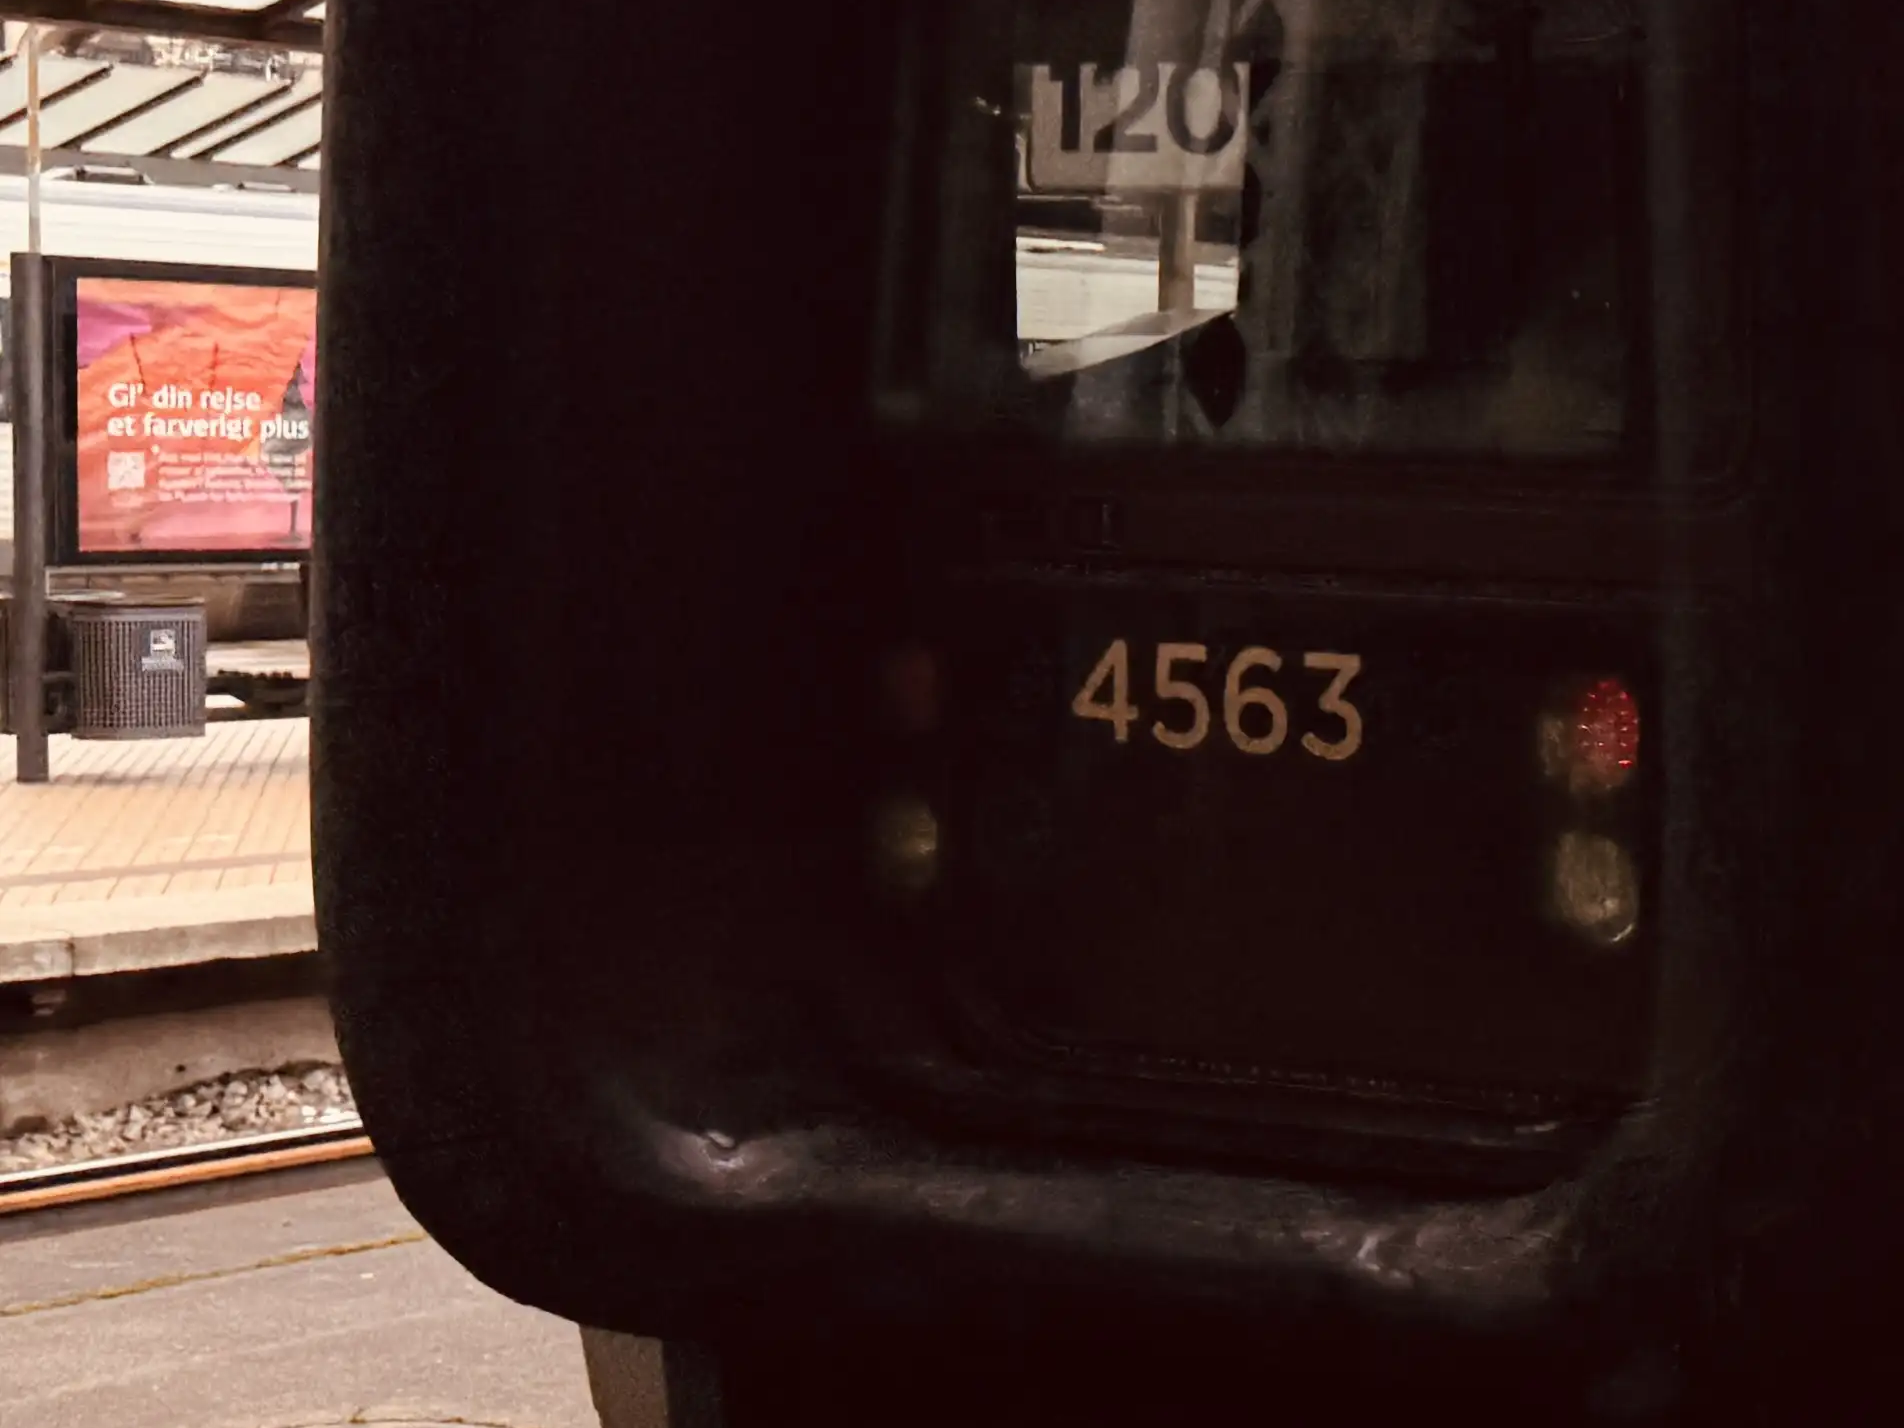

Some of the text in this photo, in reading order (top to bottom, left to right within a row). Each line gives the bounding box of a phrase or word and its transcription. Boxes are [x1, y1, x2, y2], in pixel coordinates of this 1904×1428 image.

[108, 382, 262, 414] Gi' din rejse
[107, 412, 310, 443] et farverigt plus
[1071, 638, 1364, 762] 4563
